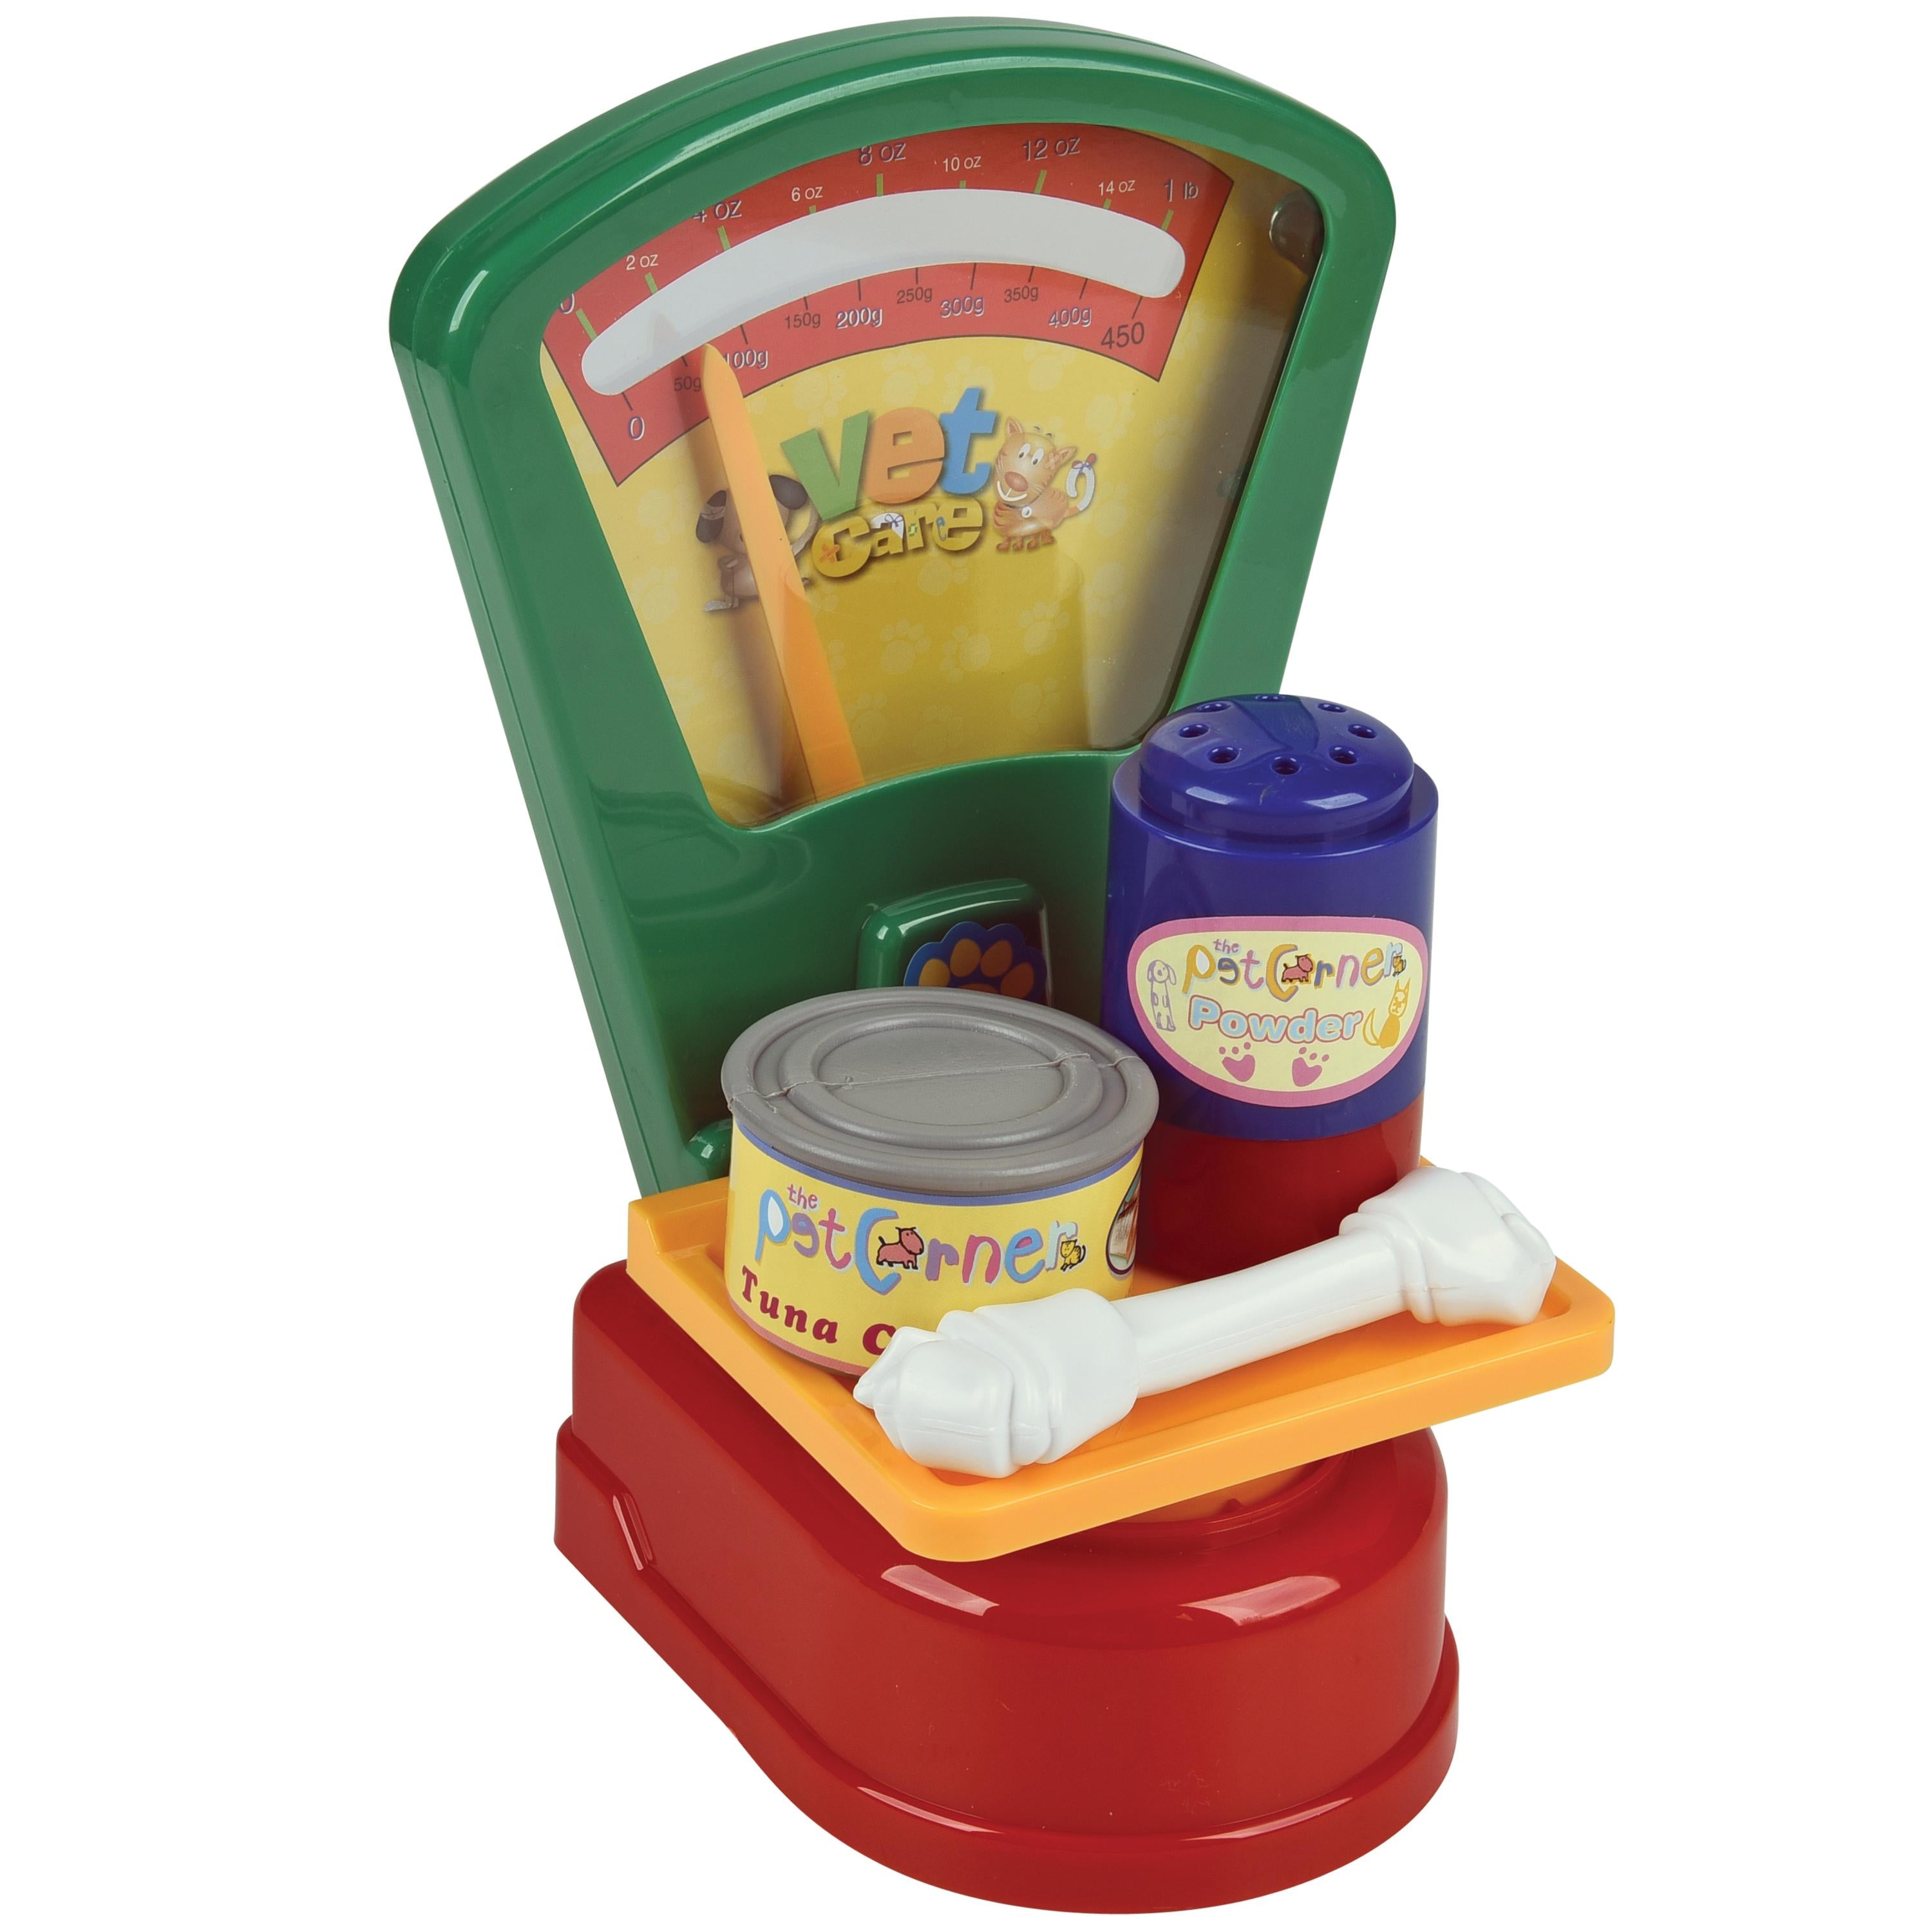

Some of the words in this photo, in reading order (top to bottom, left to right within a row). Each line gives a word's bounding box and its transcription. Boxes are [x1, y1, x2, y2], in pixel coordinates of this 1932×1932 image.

[859, 146, 873, 166] 8
[1023, 138, 1048, 162] 12
[943, 156, 961, 172] 10
[791, 187, 800, 201] 6
[1098, 181, 1115, 196] 14
[1164, 178, 1173, 202] 1
[626, 256, 635, 270] 2
[896, 287, 933, 304] 250g
[1003, 285, 1039, 303] 350g
[940, 296, 985, 318] 300g
[784, 312, 821, 329] 150g
[835, 307, 884, 328] 200g
[1048, 307, 1092, 328] 400g
[1101, 322, 1145, 350] 450
[674, 376, 701, 392] 50g
[627, 416, 645, 440] 0
[1213, 939, 1239, 954] the
[1188, 995, 1363, 1044] Powder
[787, 1184, 819, 1209] the
[741, 1265, 838, 1343] Tuna
